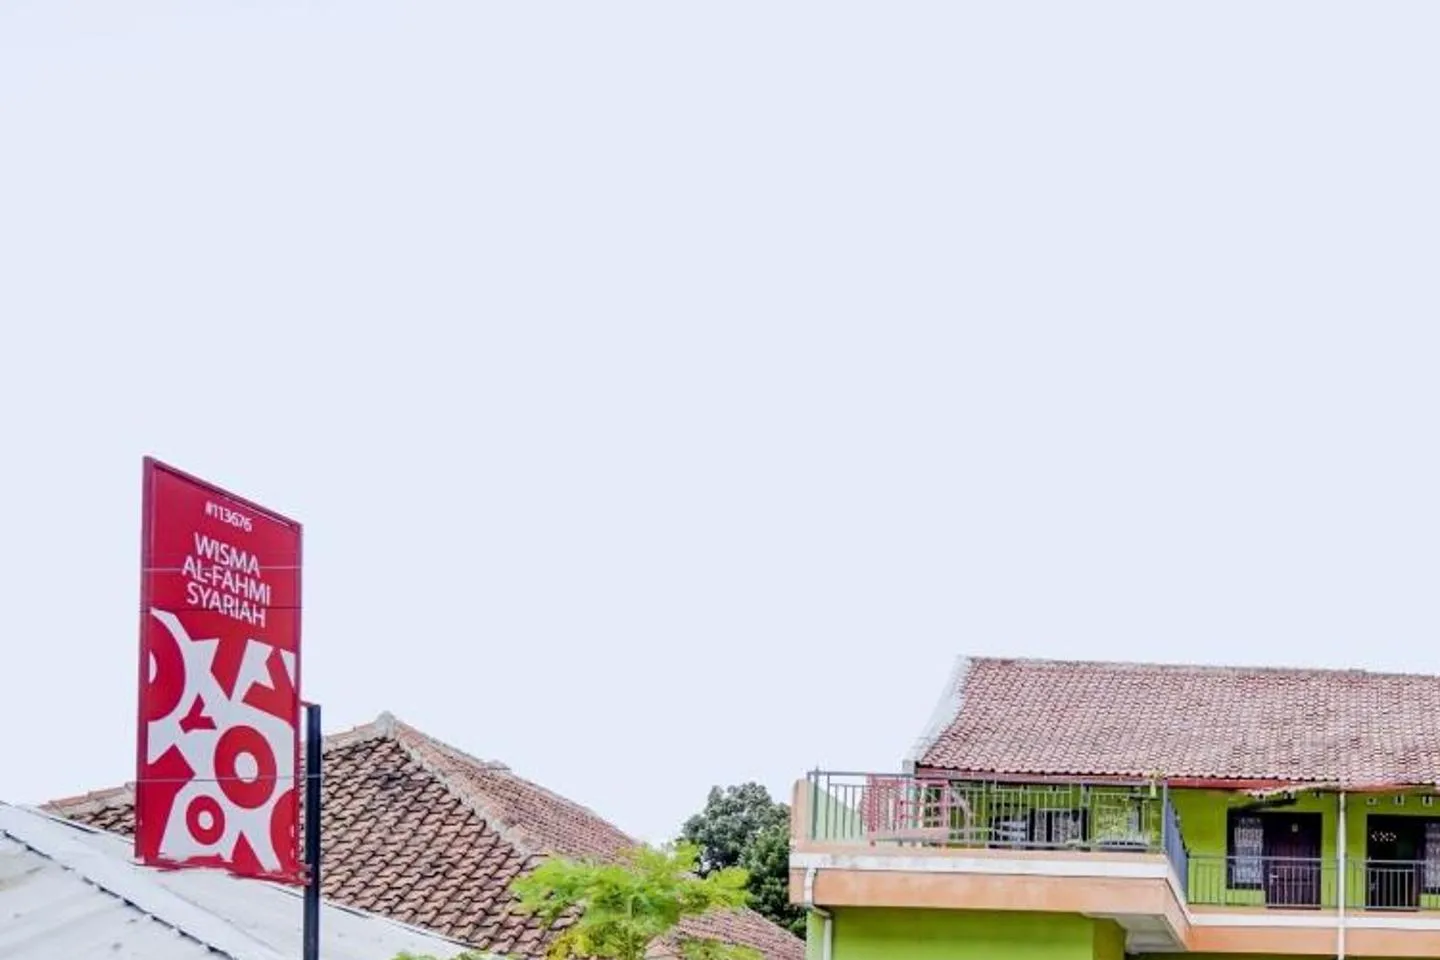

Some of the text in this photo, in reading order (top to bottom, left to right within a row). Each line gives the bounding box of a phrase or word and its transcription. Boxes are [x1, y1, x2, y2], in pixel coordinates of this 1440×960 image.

[194, 531, 261, 578] WISMA
[182, 555, 271, 606] AL-FAHMI
[187, 581, 267, 628] SYARIAH
